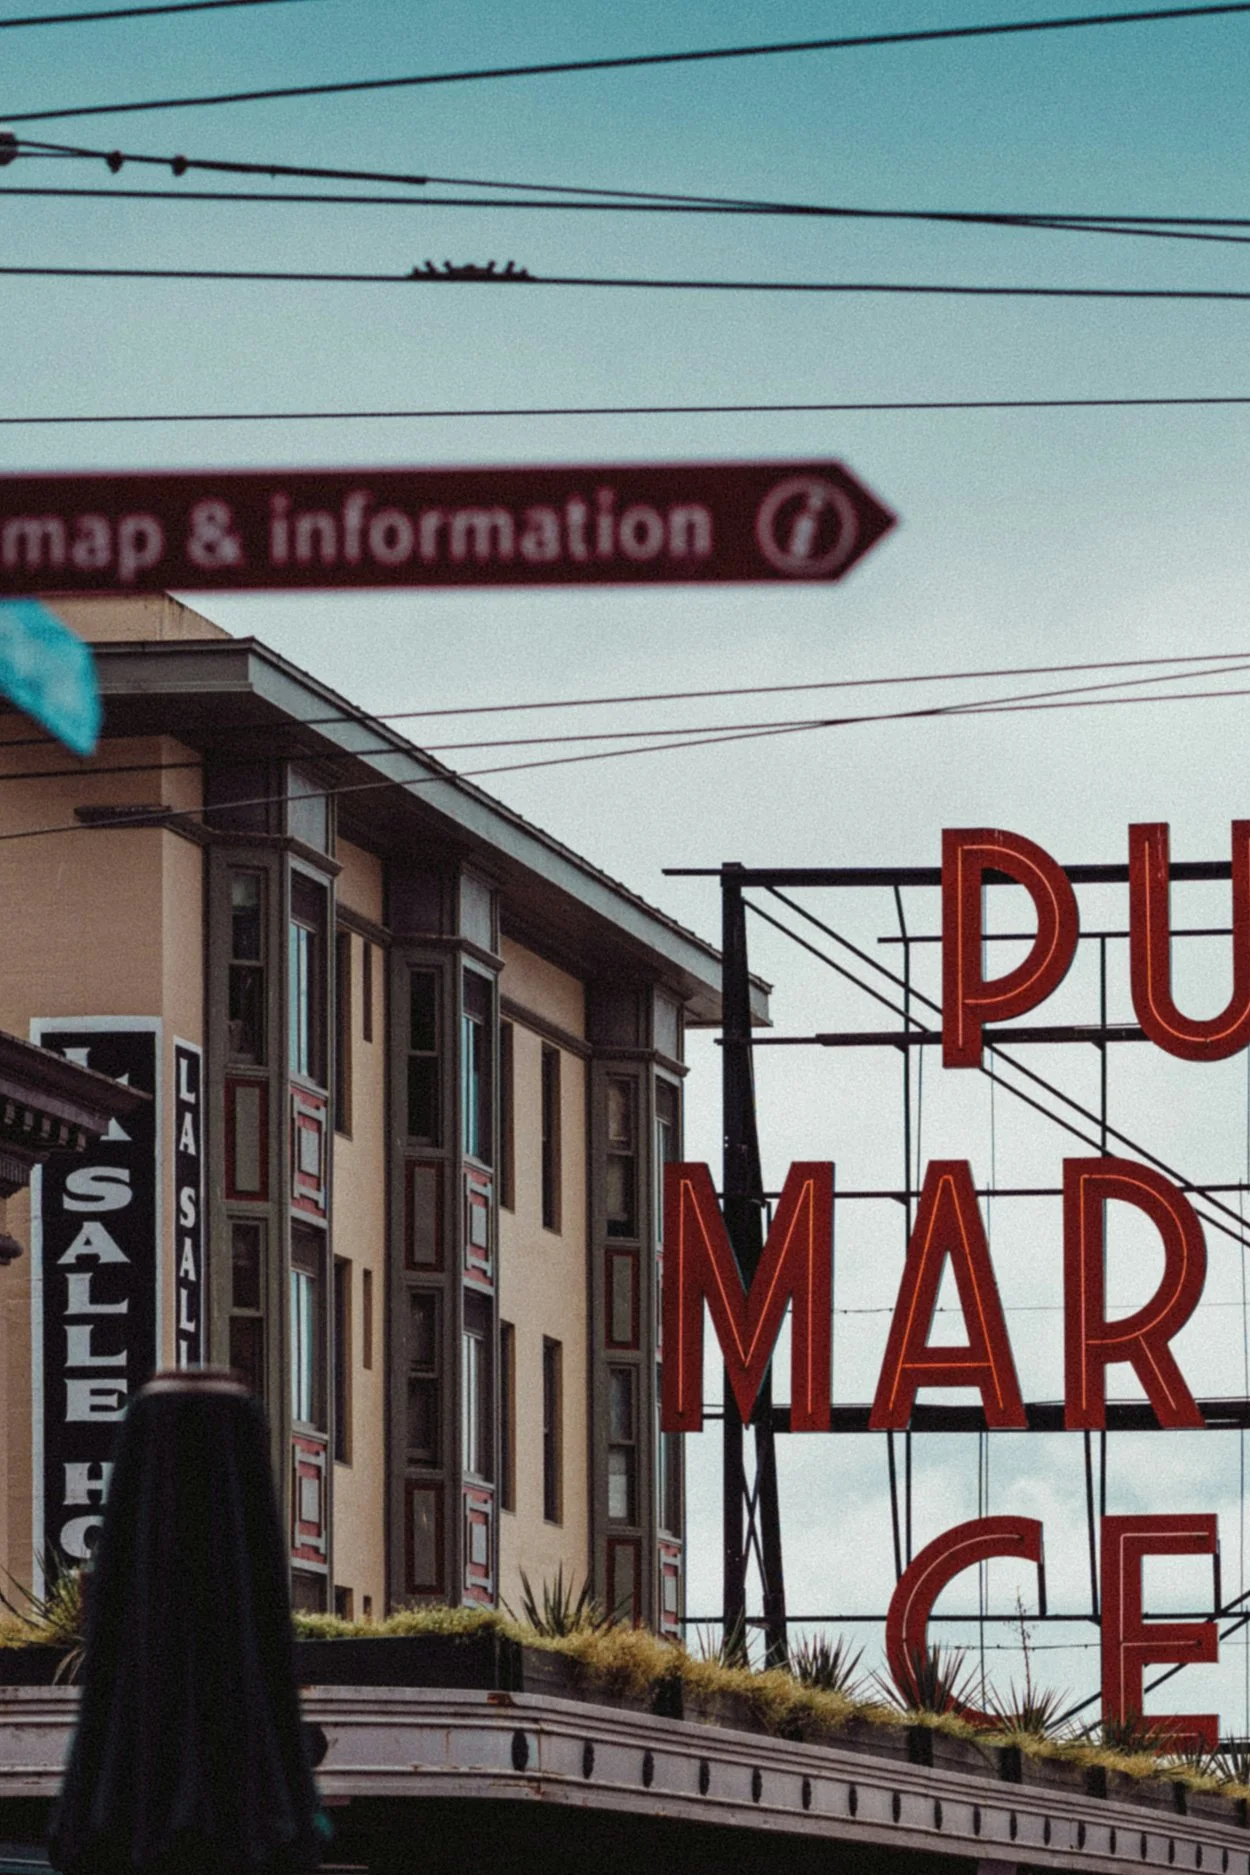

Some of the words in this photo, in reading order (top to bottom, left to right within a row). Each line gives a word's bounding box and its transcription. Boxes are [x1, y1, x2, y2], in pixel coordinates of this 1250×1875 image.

[2, 518, 165, 580] map
[188, 499, 244, 568] &
[270, 490, 712, 564] information
[177, 1058, 198, 1156] LA
[56, 1166, 135, 1423] SALLE
